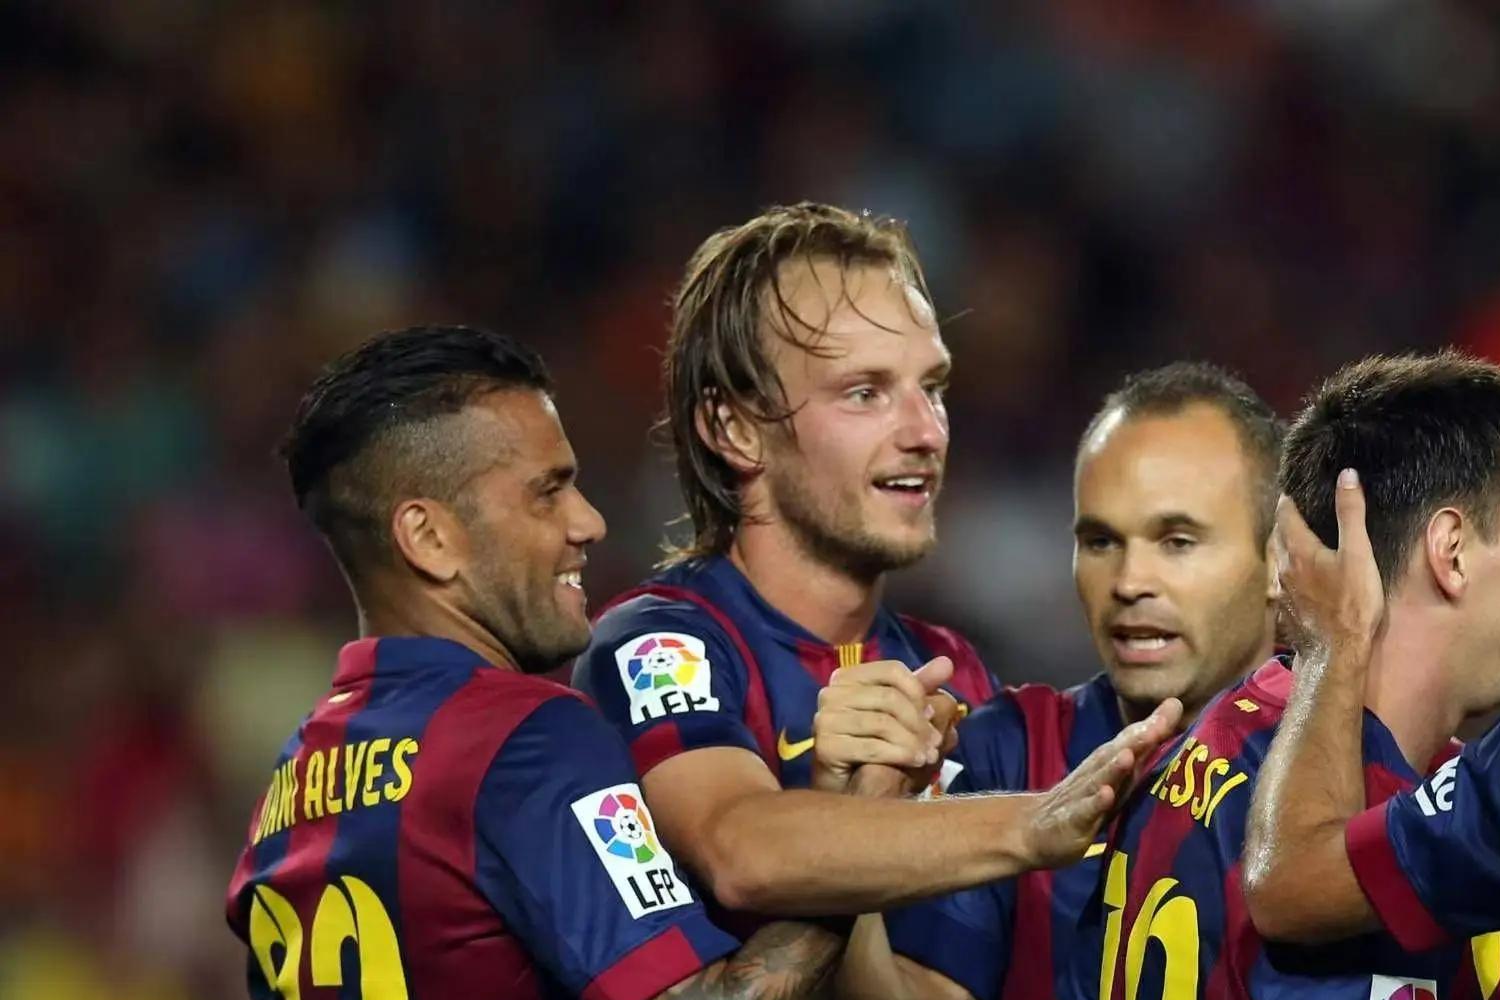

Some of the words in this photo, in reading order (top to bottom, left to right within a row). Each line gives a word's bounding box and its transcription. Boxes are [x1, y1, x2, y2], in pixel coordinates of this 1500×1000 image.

[304, 735, 419, 820] ALVES
[1150, 736, 1248, 829] ESSI
[626, 868, 677, 909] LFP
